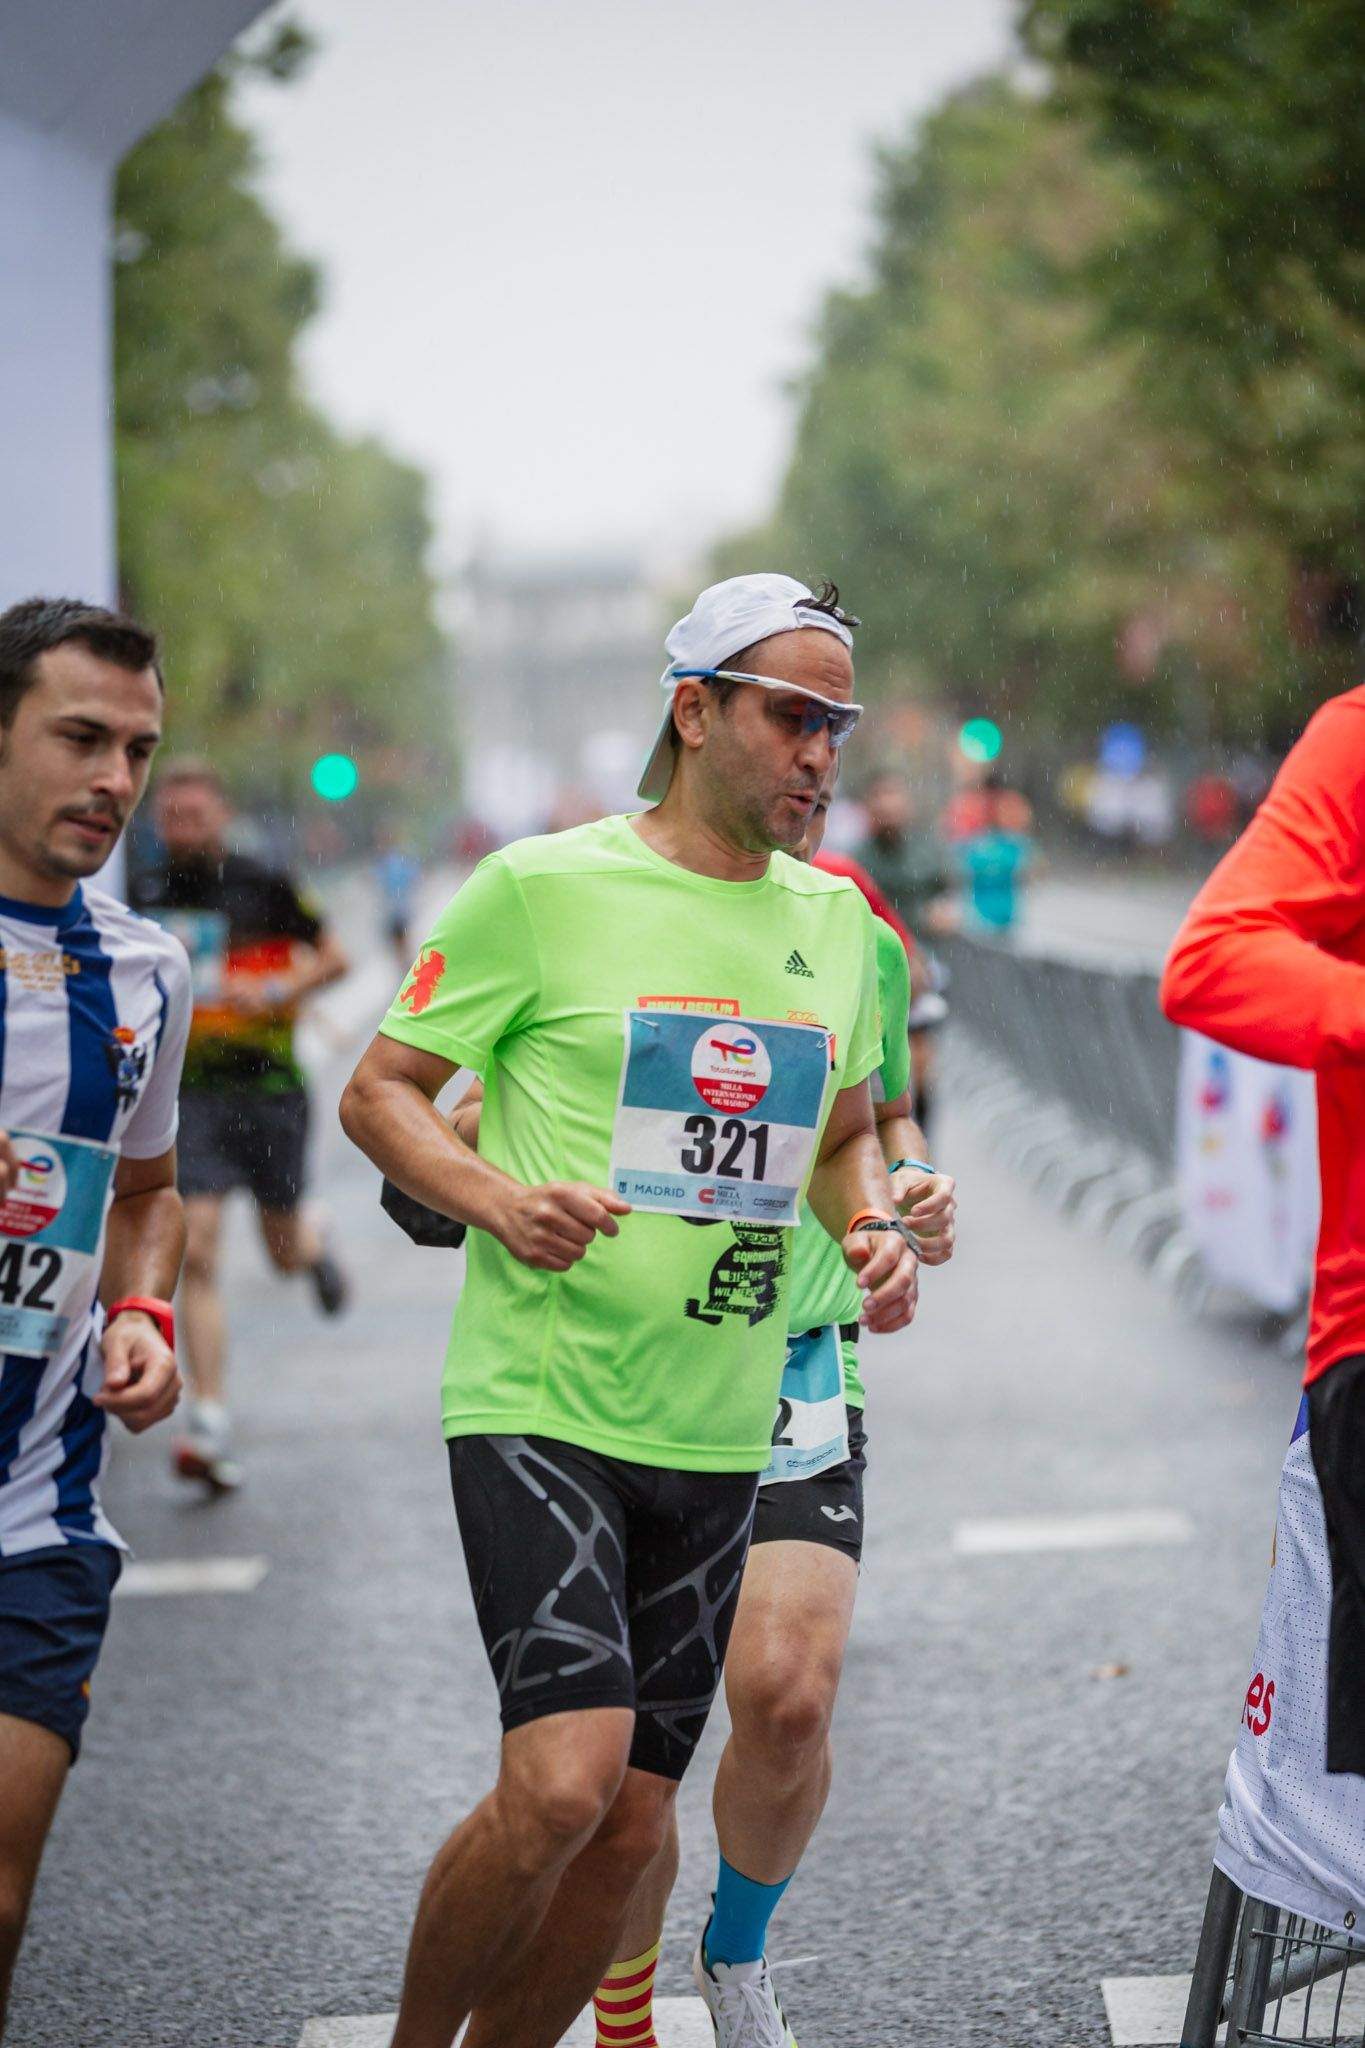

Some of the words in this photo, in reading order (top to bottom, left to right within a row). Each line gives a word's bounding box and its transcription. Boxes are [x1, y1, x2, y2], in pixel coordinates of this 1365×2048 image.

[710, 1065, 756, 1078] TotalEnergies
[720, 1082, 743, 1092] MILLA
[681, 1115, 769, 1181] 321
[634, 1184, 685, 1198] MADRID
[0, 1243, 63, 1311] 42
[771, 1397, 793, 1446] 2
[1241, 1672, 1275, 1736] es
